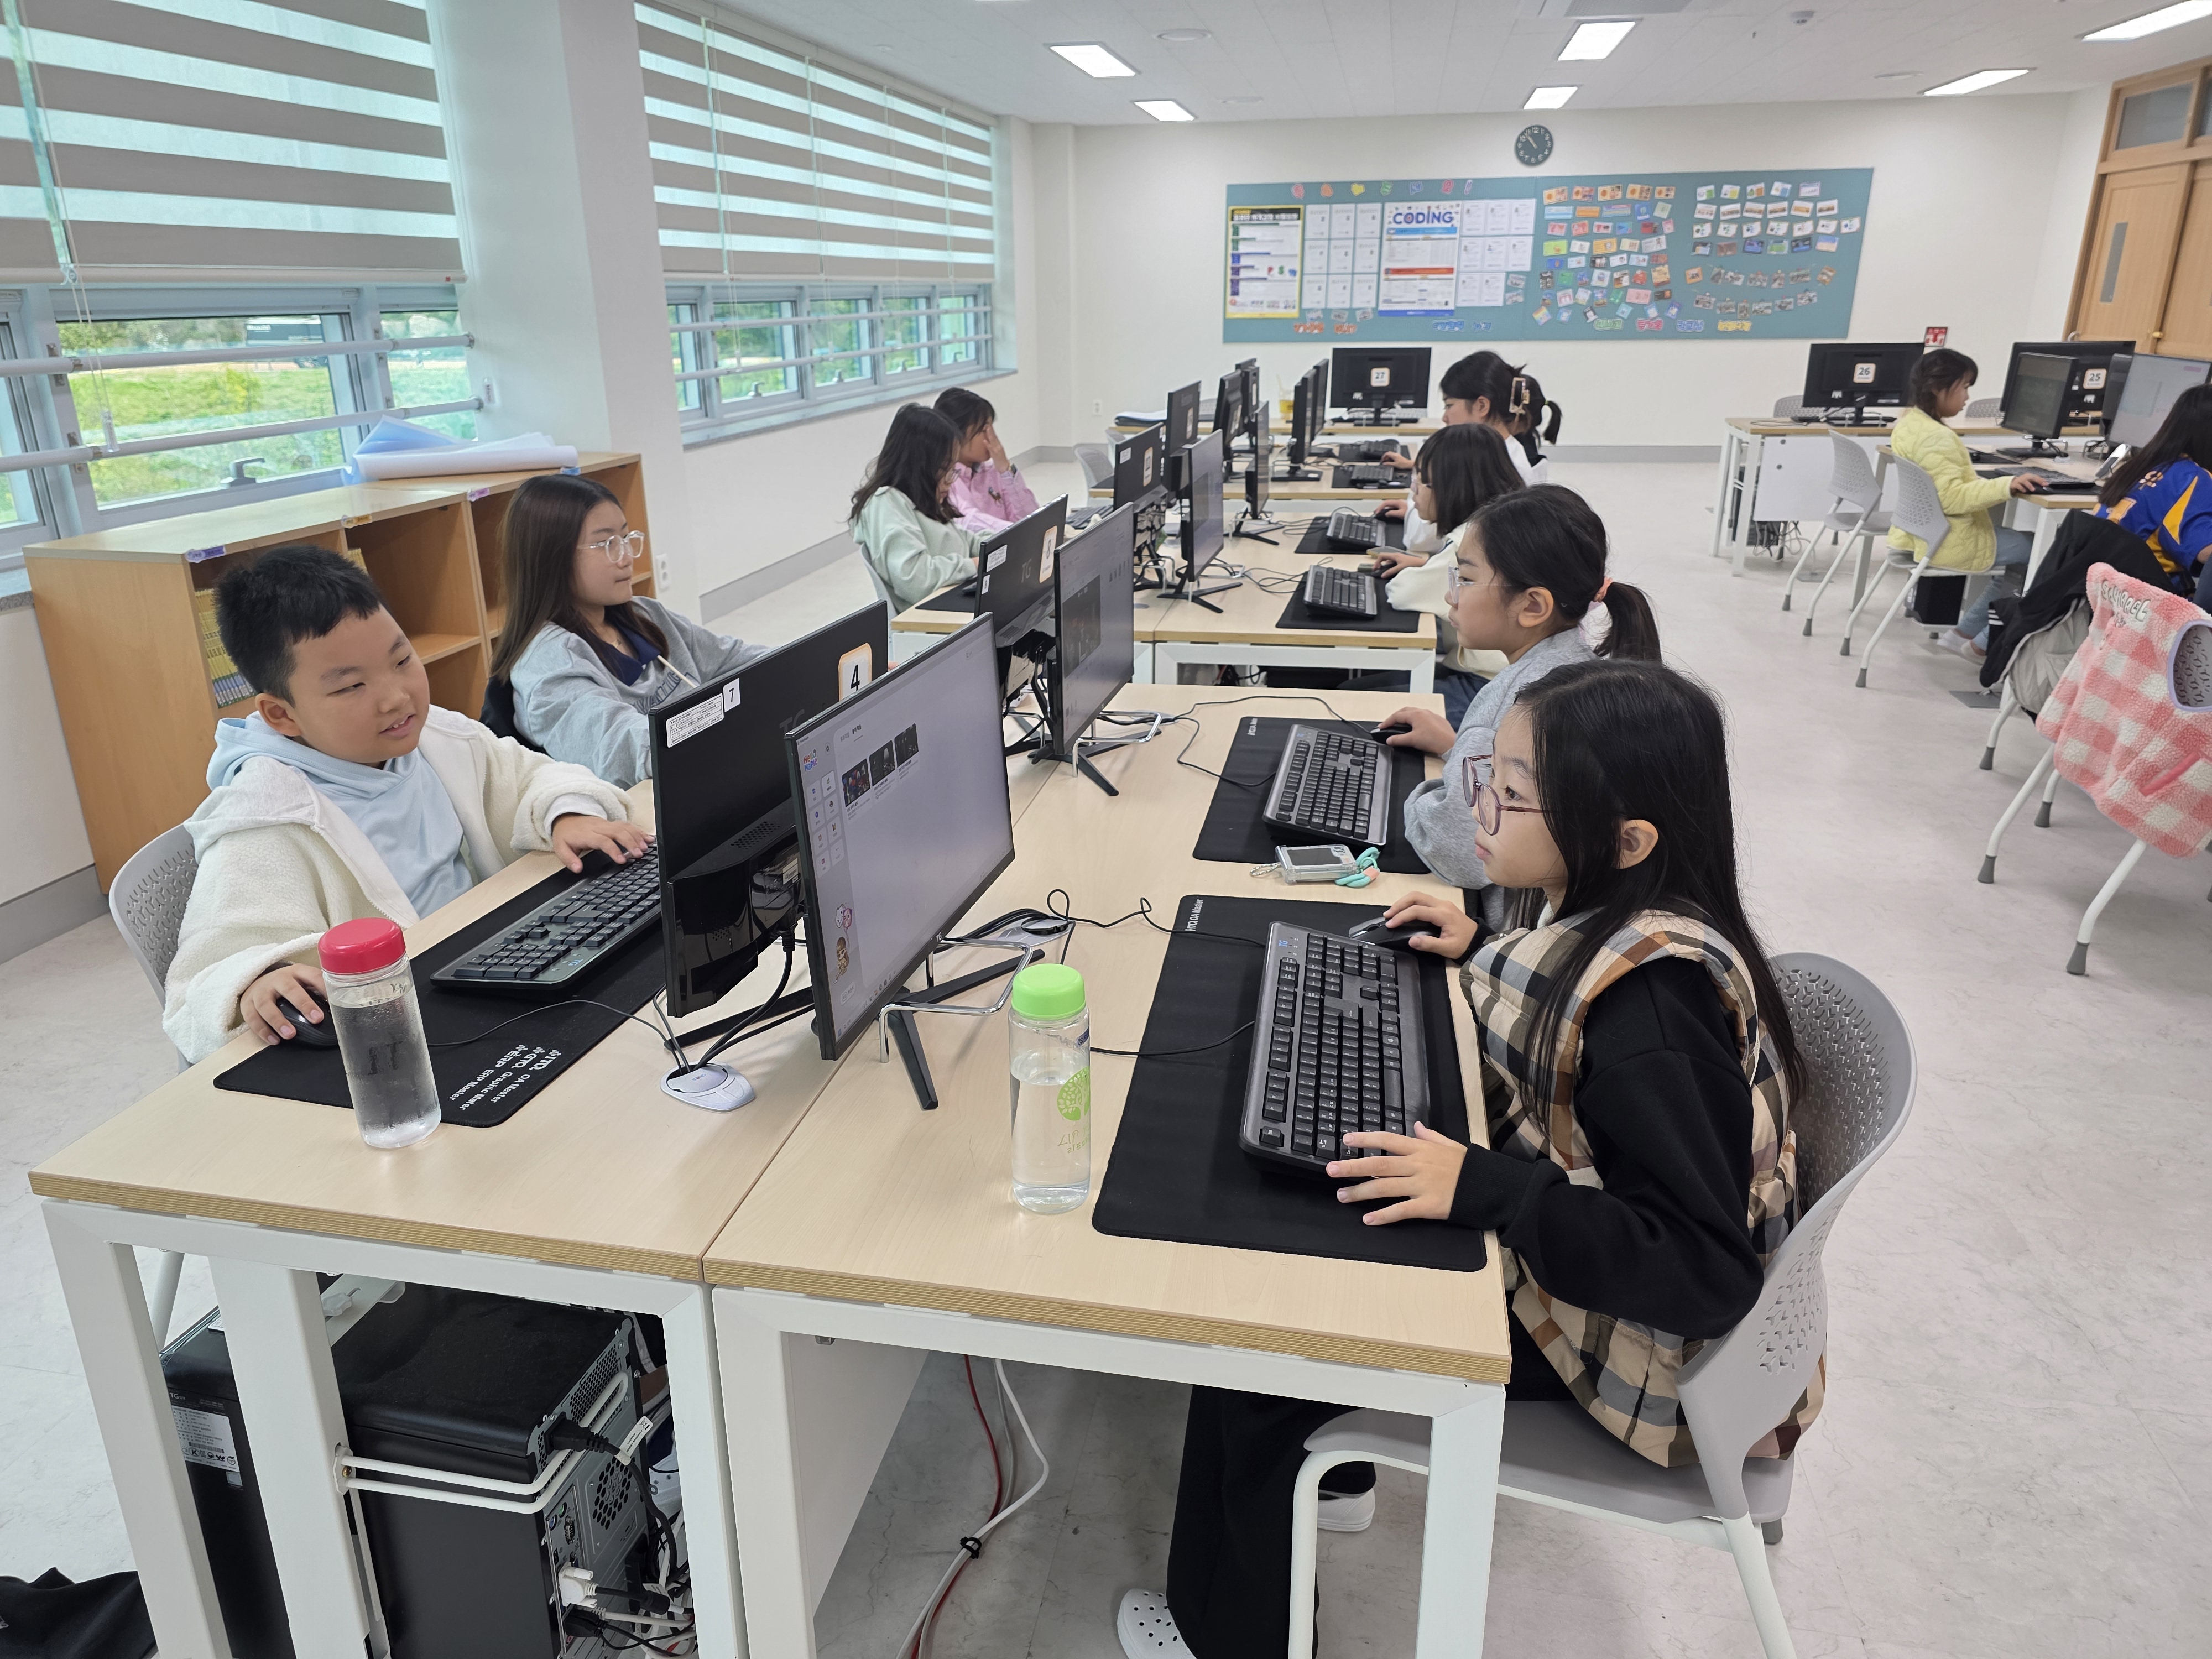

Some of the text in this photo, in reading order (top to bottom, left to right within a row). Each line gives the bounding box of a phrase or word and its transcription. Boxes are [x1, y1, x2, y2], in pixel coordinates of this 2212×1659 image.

[1392, 211, 1454, 225] CODING
[1375, 371, 1385, 379] 27
[1858, 367, 1871, 375] 26
[2089, 373, 2101, 382] 25
[1021, 558, 1032, 583] TG
[851, 664, 860, 691] 4
[729, 687, 734, 703] 7
[803, 749, 817, 764] Hello
[804, 757, 818, 772] Maple
[936, 932, 942, 943] TG
[460, 1053, 538, 1110] GTQ Graphic Mater
[477, 1069, 495, 1081] ERP
[491, 1055, 557, 1103] ITQ OA Master
[448, 1081, 479, 1100] Master
